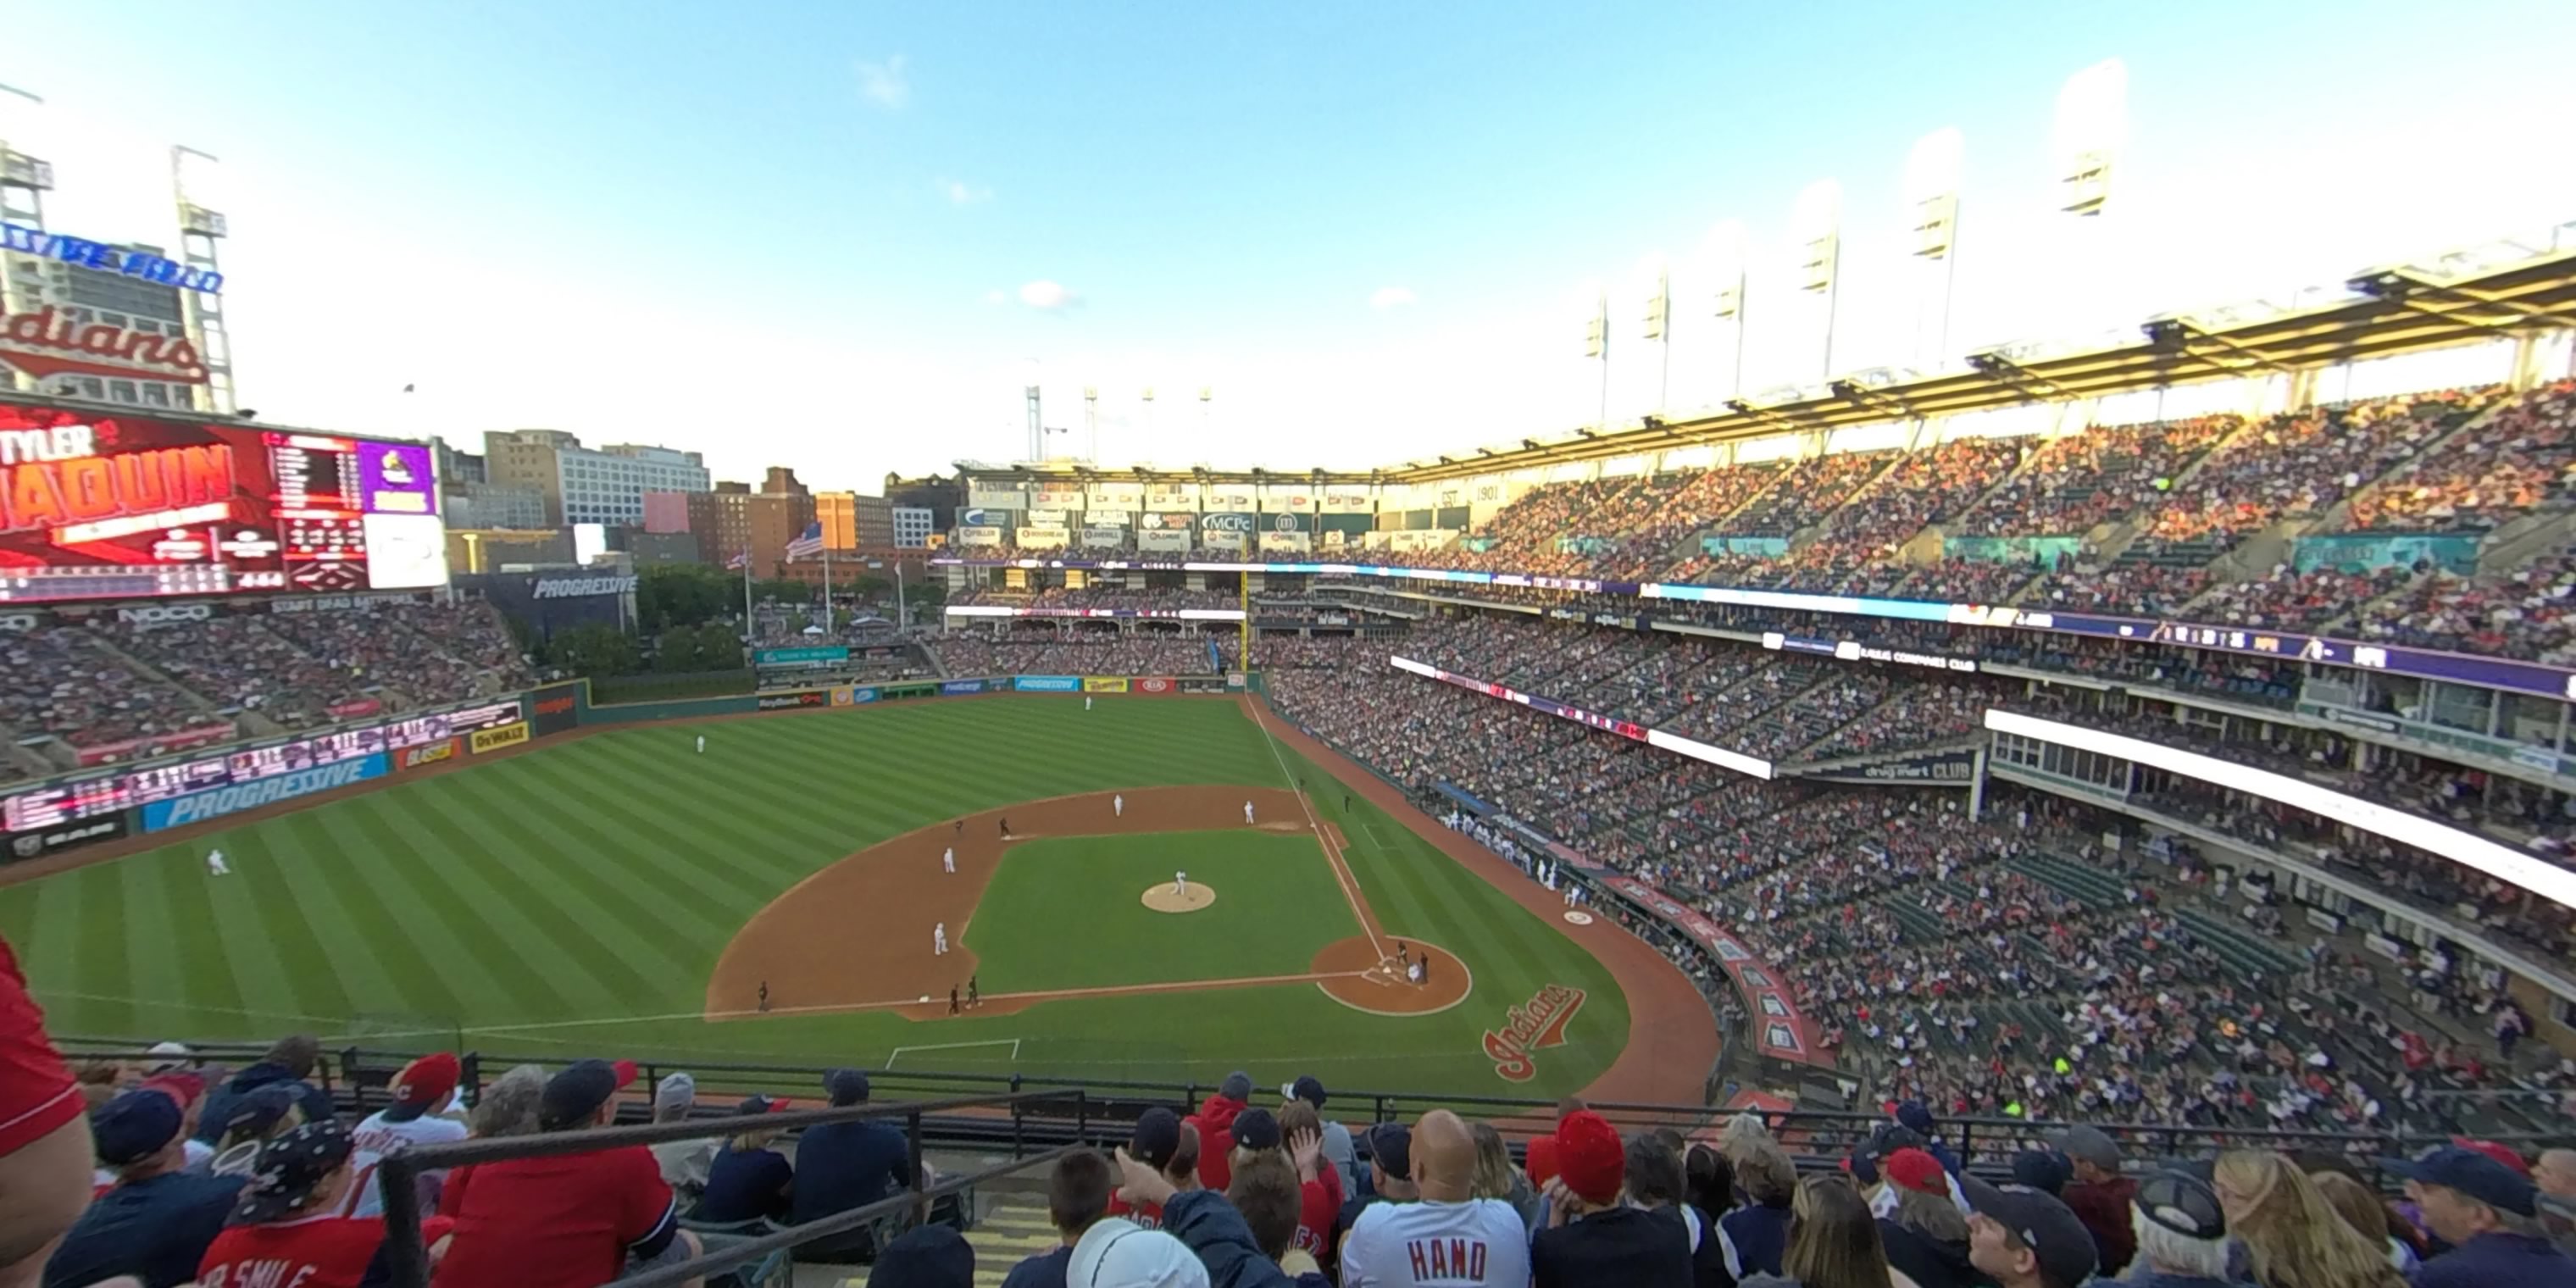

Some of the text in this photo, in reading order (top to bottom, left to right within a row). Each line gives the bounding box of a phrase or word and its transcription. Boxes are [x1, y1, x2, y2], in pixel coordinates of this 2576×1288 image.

[0, 304, 208, 373] dians
[0, 425, 96, 464] TYLER
[1478, 486, 1498, 501] 1901
[532, 575, 638, 599] PROGRESSIVE
[118, 605, 212, 625] NOCO
[1933, 763, 1970, 779] CLUB
[166, 759, 368, 827] PROGRESSIVE
[1482, 984, 1579, 1082] Indians
[1407, 1241, 1487, 1283] HAND
